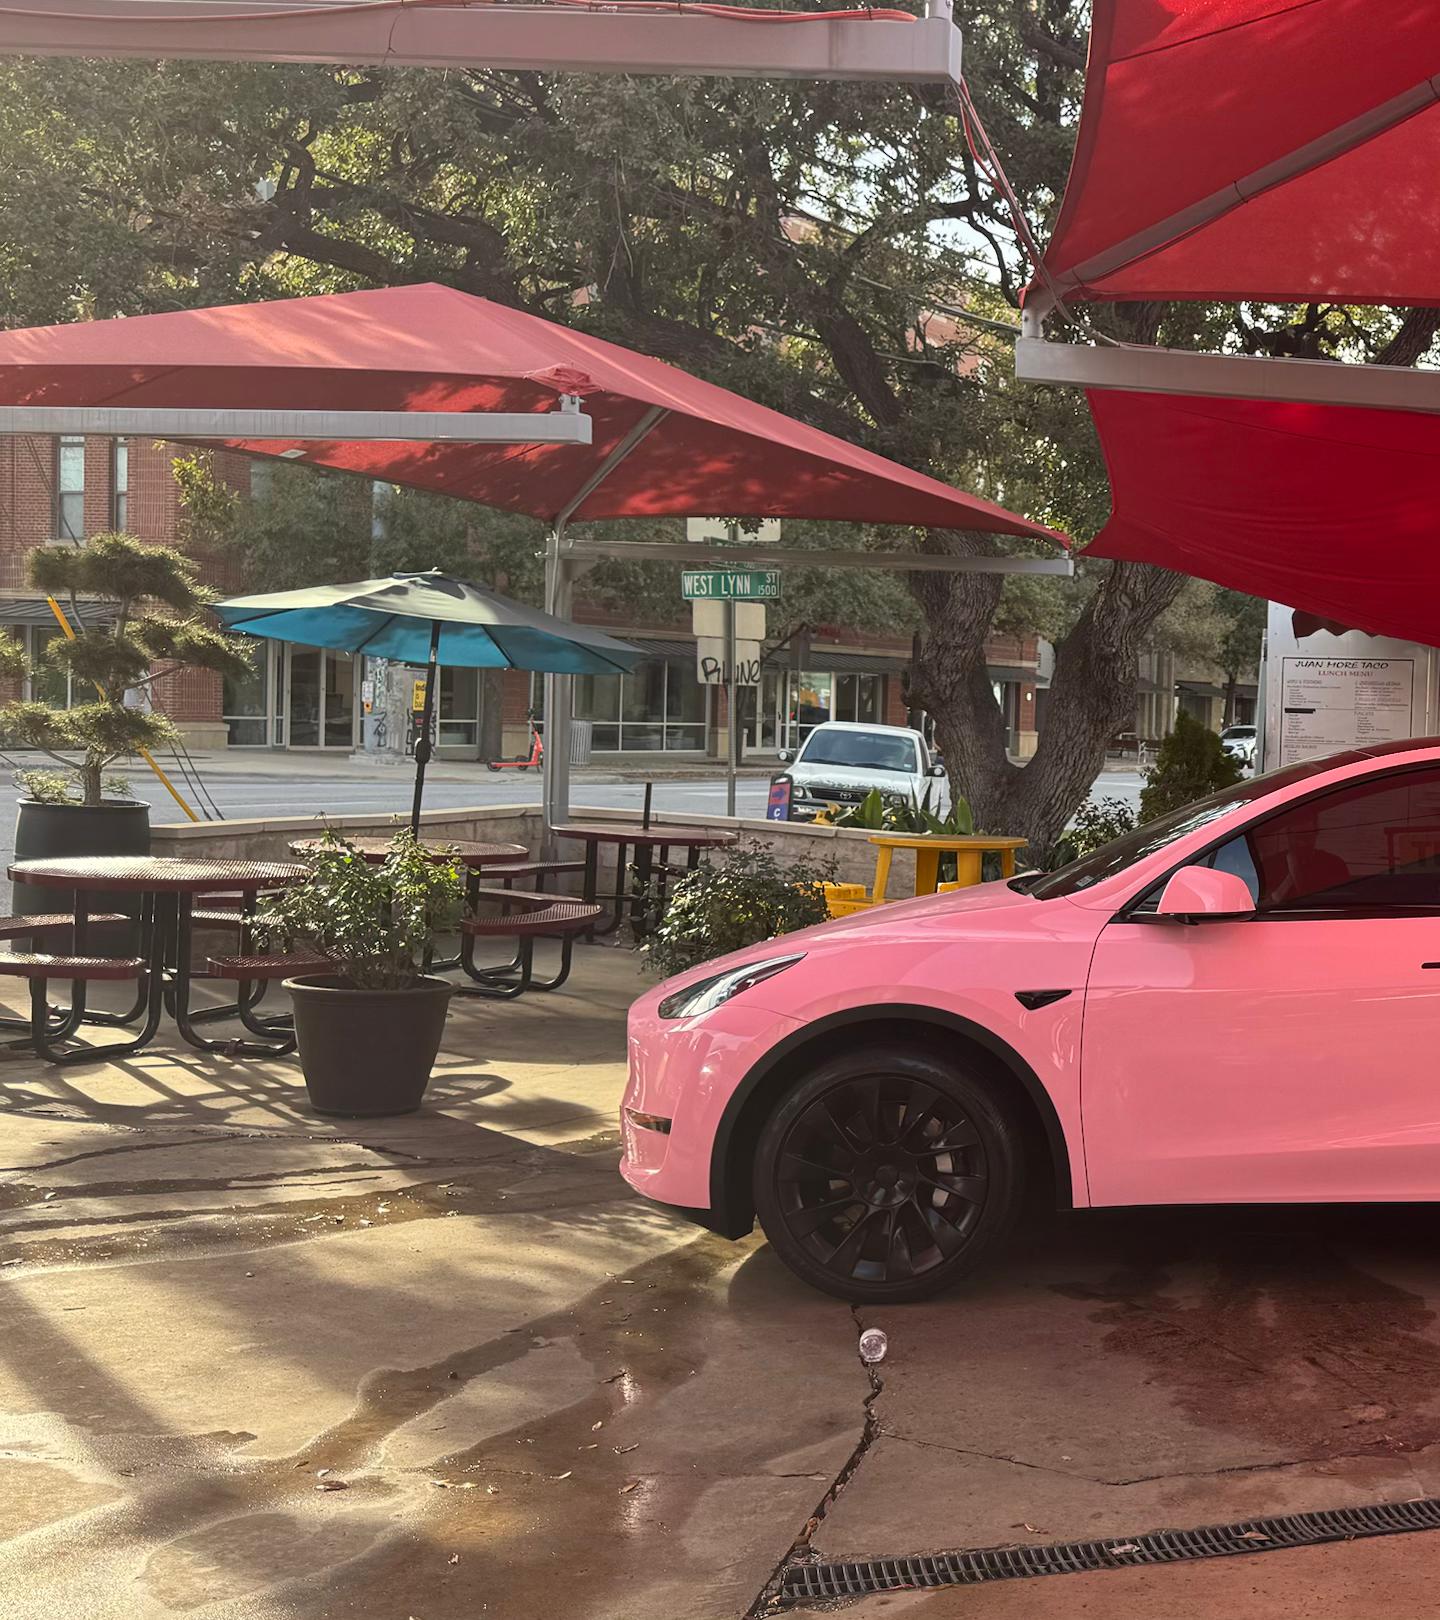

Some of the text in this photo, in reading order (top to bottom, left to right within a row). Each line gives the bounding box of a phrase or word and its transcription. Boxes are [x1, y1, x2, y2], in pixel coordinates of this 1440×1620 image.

[683, 572, 777, 595] WEST LYNN ST
[758, 584, 777, 595] 1500
[1295, 660, 1323, 668] JUAN
[1362, 661, 1389, 669] TACO
